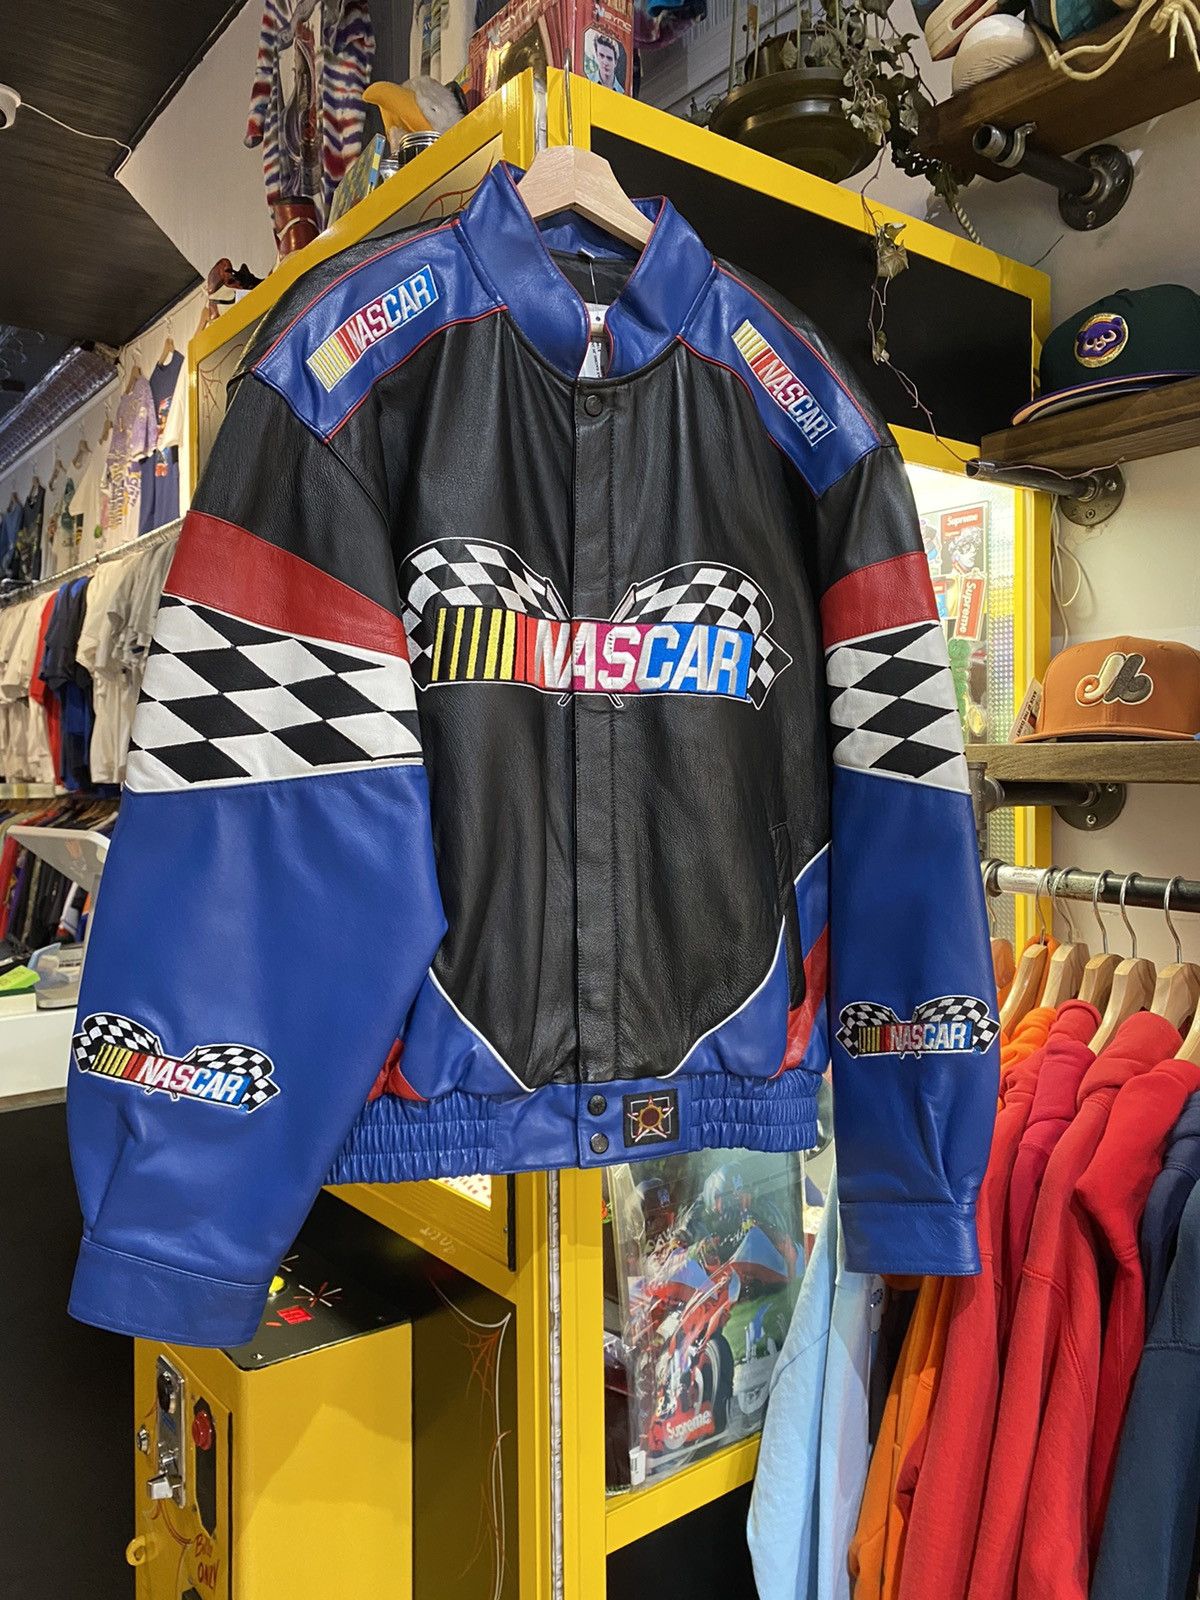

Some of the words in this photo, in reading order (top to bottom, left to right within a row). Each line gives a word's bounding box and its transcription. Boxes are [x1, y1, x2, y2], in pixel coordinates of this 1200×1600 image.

[345, 274, 432, 352] NASCAR
[757, 359, 829, 440] NASCAR
[960, 581, 977, 634] Supreme
[533, 618, 742, 695] NASCAR
[889, 1021, 967, 1052] NASCAR
[134, 1055, 244, 1103] NASCAR
[666, 1410, 712, 1441] Supreme
